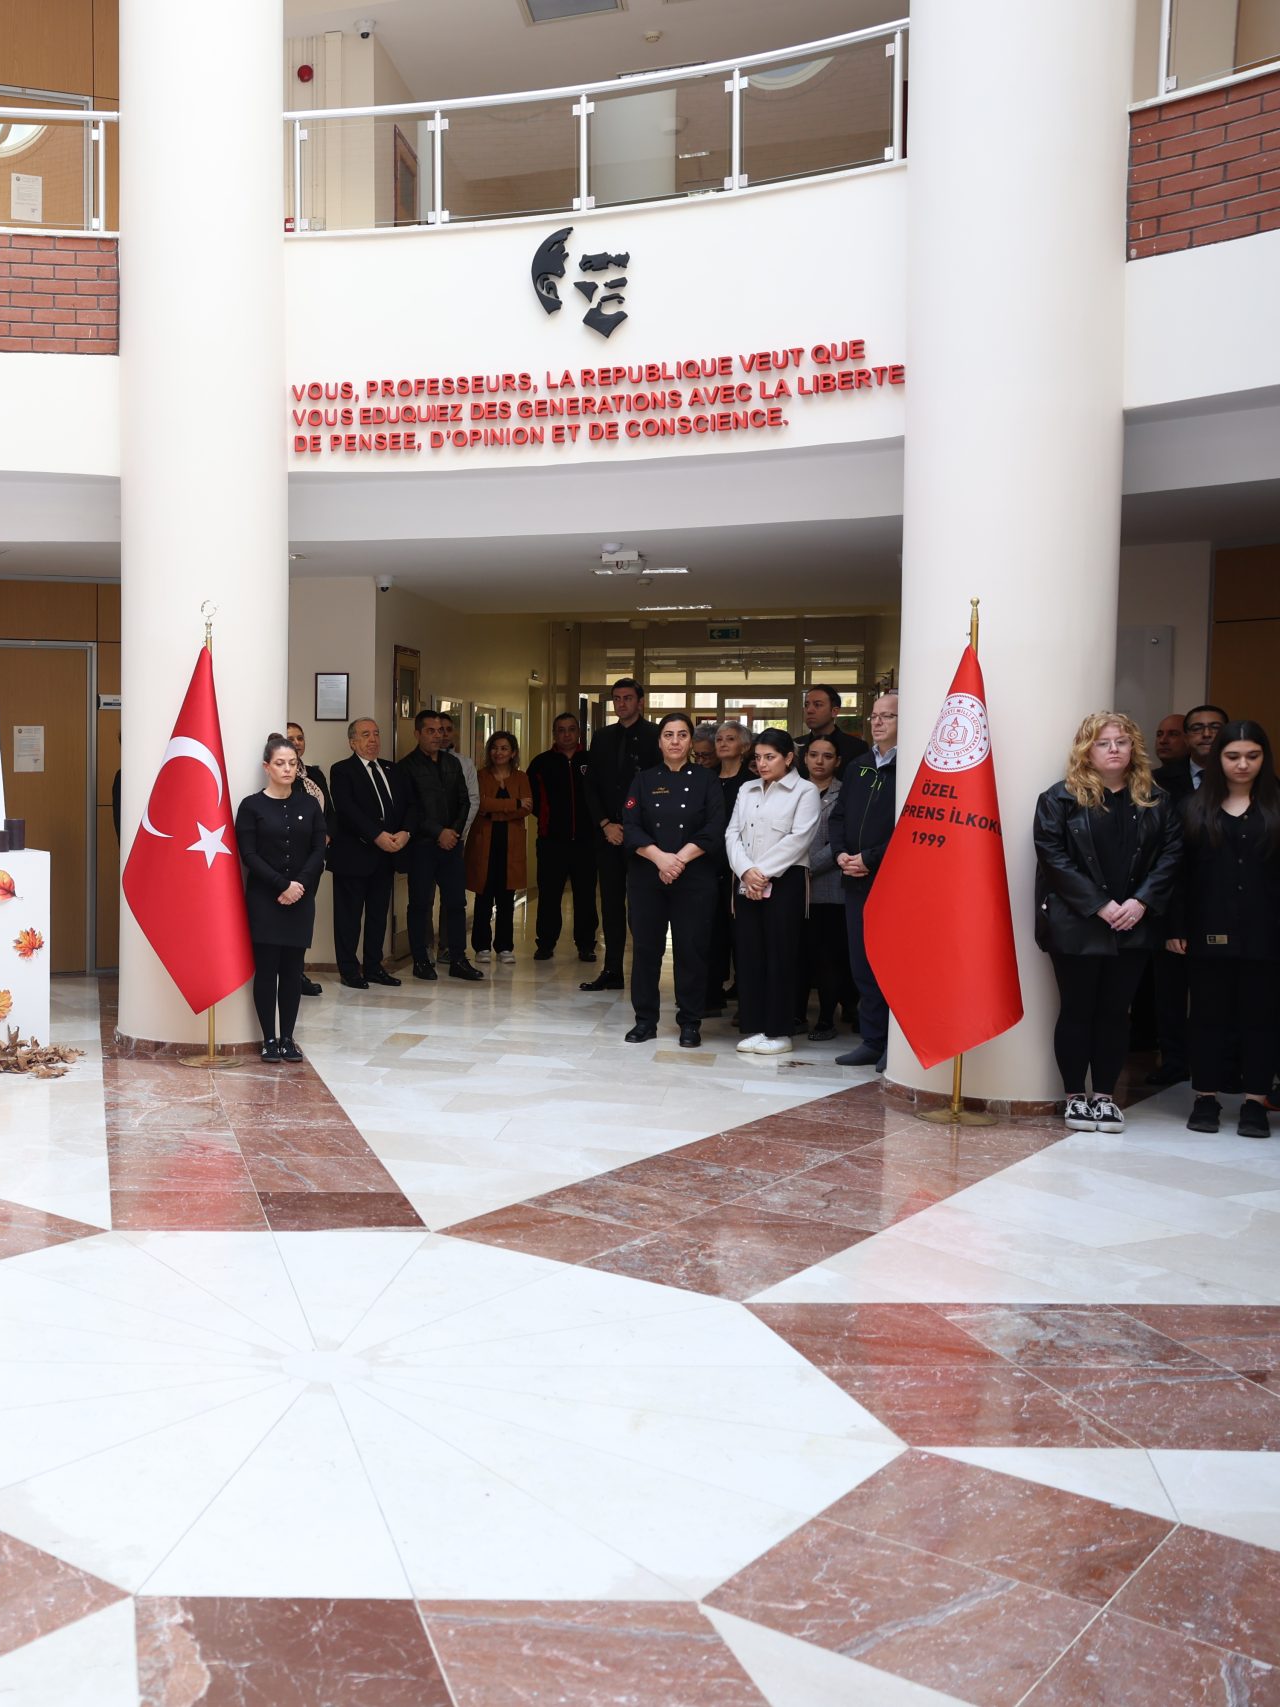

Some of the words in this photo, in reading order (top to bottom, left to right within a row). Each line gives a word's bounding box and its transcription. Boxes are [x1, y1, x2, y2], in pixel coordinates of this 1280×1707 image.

[292, 382, 359, 402] VOUS,
[366, 373, 538, 399] PROFESSEURS,
[546, 369, 575, 389] LA
[580, 356, 732, 387] REPUBLIQUE
[739, 347, 805, 373] VEUT
[811, 339, 865, 364] QUE
[292, 407, 353, 426] VOUS
[359, 403, 463, 424] EDUQUIEZ
[470, 400, 512, 419] DES
[516, 389, 682, 419] GENERATIONS
[688, 383, 753, 407] AVEC
[759, 378, 792, 400] LA
[797, 364, 905, 396] LIBERTE
[294, 434, 322, 452] DE
[330, 431, 422, 452] PENSEE,
[430, 425, 545, 449] D'OPINION
[551, 423, 580, 443] ET
[589, 421, 619, 440] DE
[625, 407, 789, 438] CONSCIENCE.
[921, 779, 958, 799] ÖZEL
[903, 804, 946, 821] PRENS
[912, 831, 946, 848] 1999
